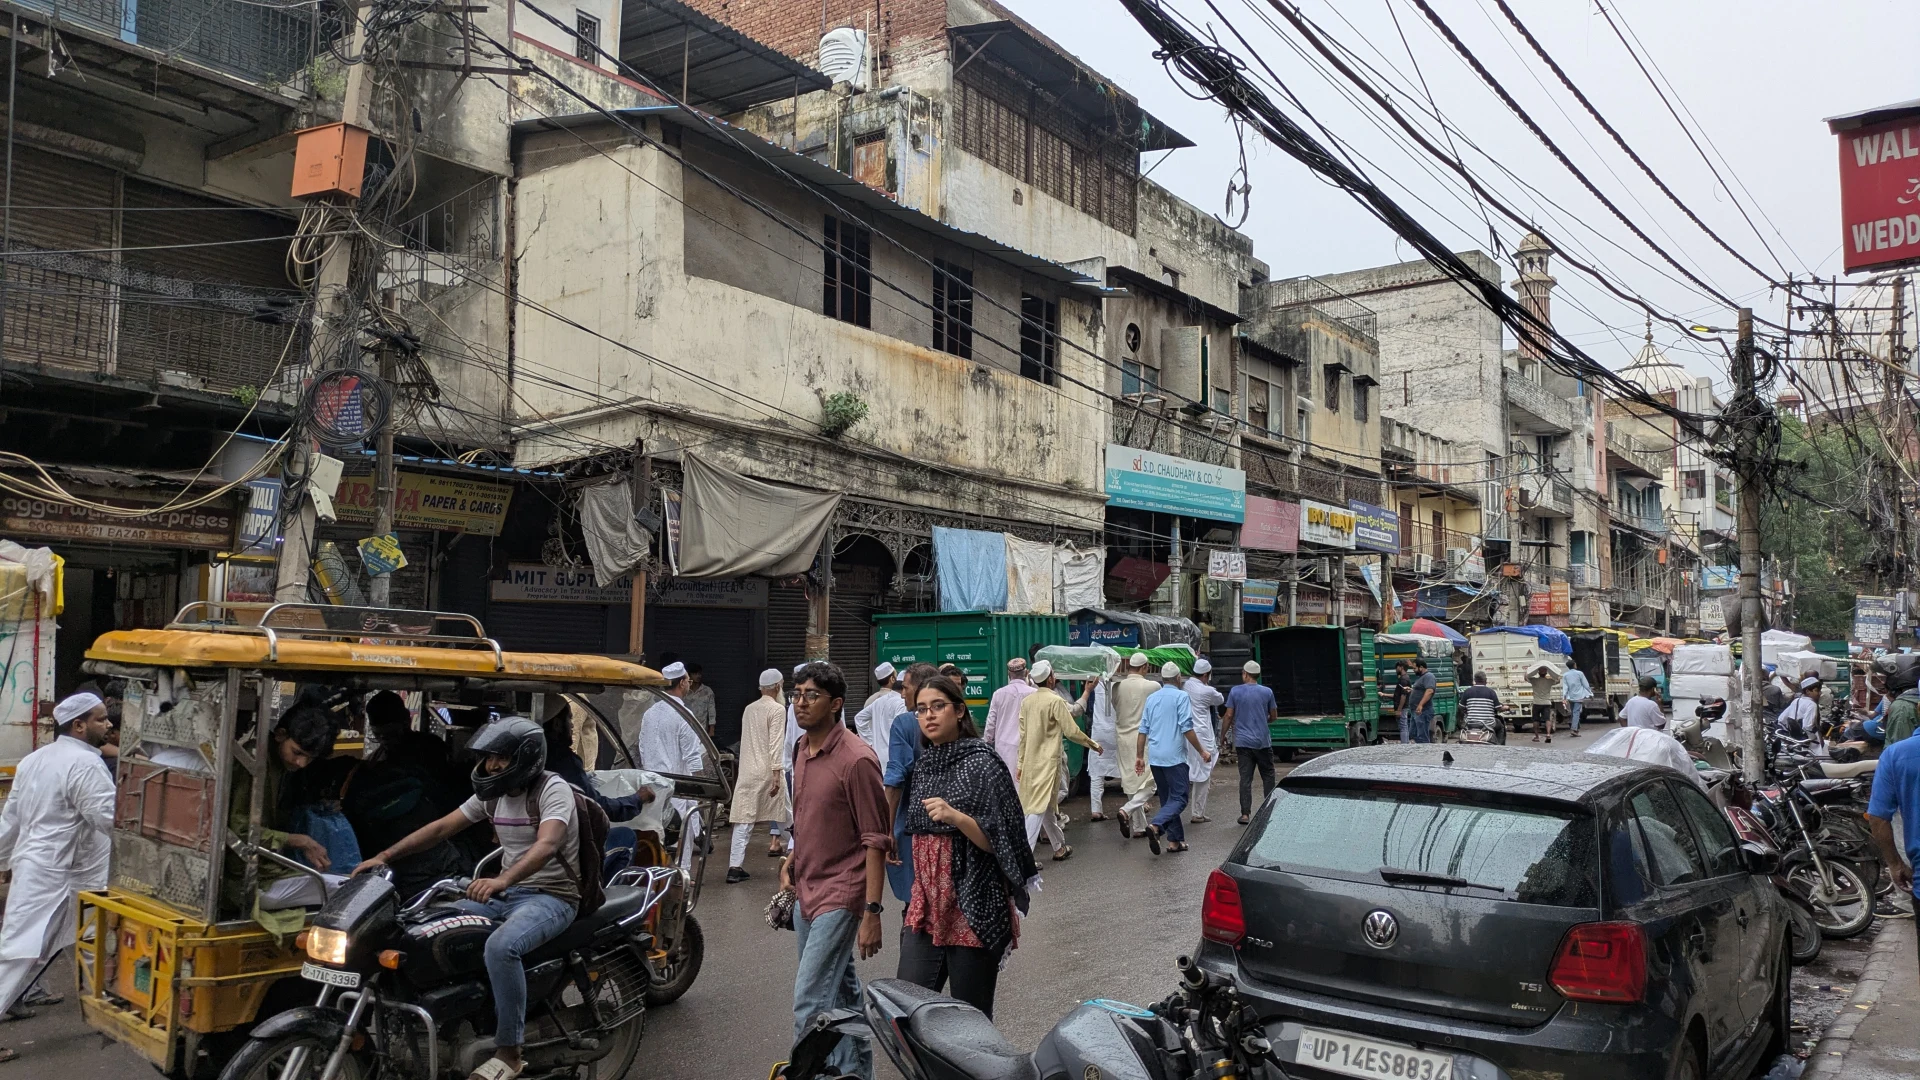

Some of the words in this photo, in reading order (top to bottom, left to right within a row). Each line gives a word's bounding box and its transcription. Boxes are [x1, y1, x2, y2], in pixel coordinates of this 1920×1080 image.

[1143, 461, 1156, 475] S.D.
[1157, 464, 1197, 482] CHAUDHARY
[1198, 472, 1203, 482] &
[422, 494, 456, 511] PAPER
[459, 499, 467, 511] &
[469, 500, 503, 515] CARDS
[241, 512, 273, 538] PAPER
[501, 568, 547, 585] AMIT
[555, 571, 605, 588] GUPT
[965, 685, 983, 696] CNG
[1302, 1042, 1314, 1051] IND
[1312, 1037, 1450, 1080] UP14ES8834
